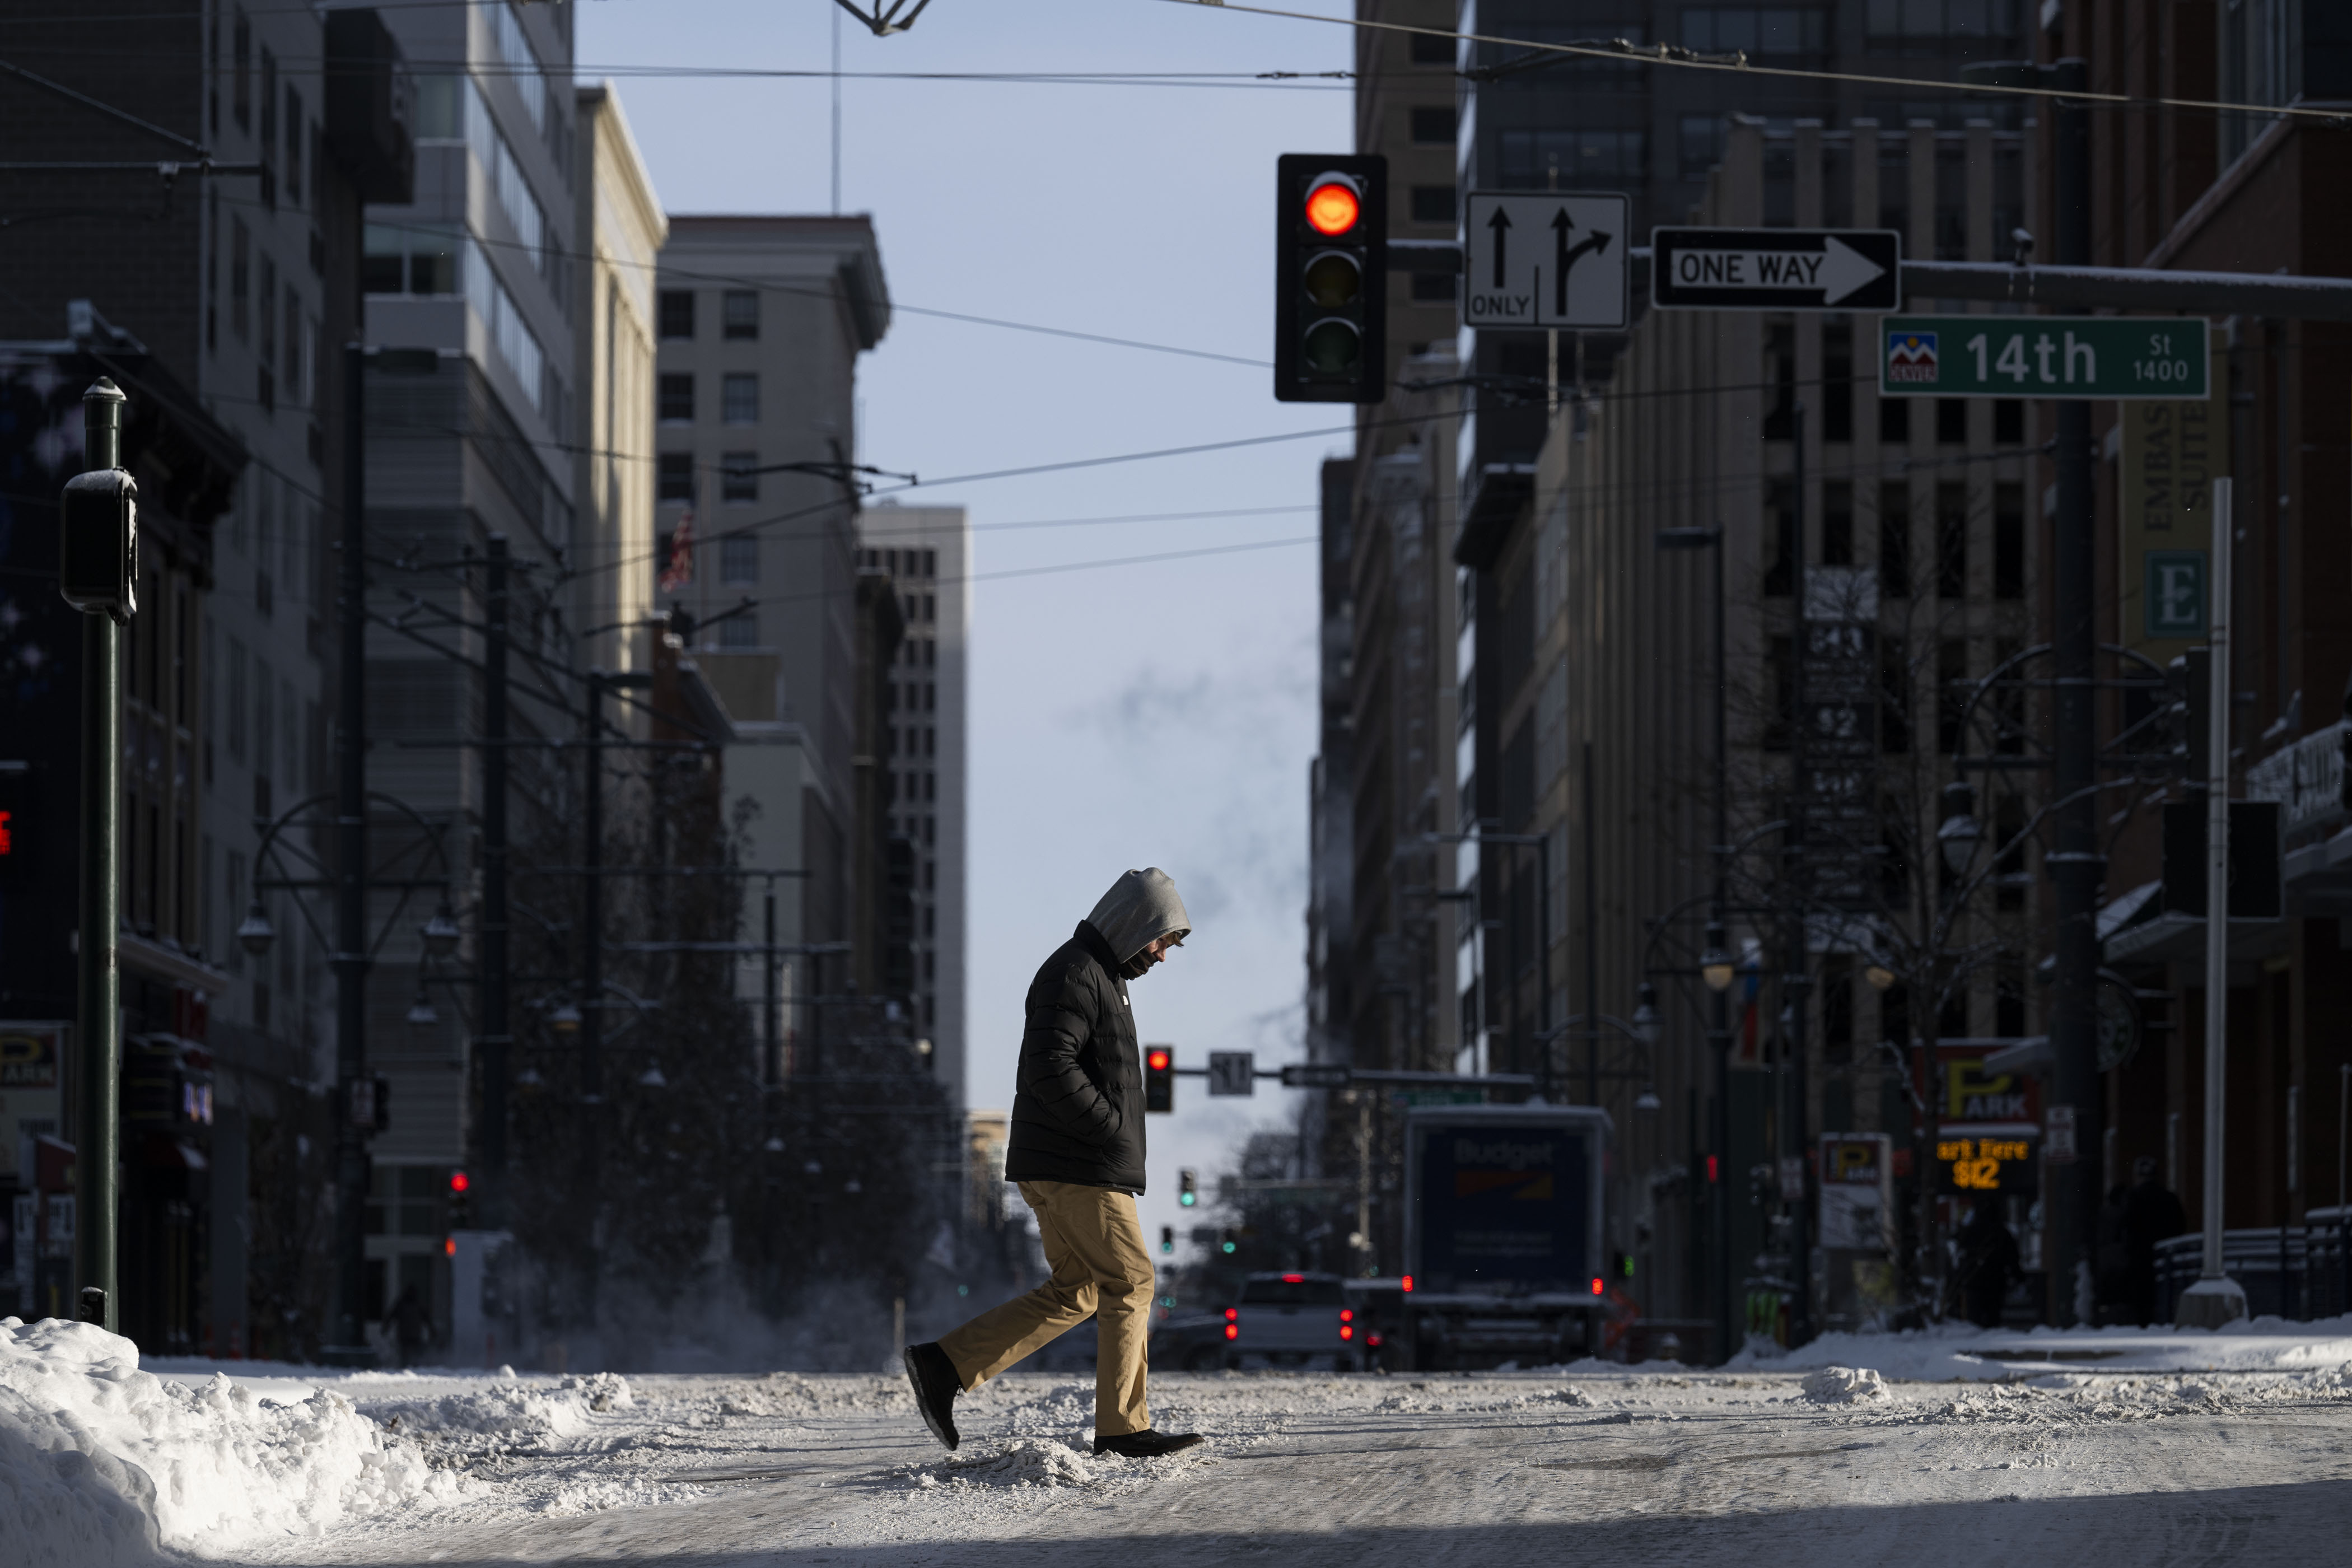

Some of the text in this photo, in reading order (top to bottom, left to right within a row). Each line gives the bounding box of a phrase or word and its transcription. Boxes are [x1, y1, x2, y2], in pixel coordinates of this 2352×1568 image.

[1680, 253, 1823, 284] ONE WAY
[1472, 295, 1530, 316] ONLY
[1966, 330, 2097, 384] 14th
[2149, 334, 2172, 356] St
[2133, 359, 2189, 382] 1400
[2144, 400, 2173, 531] EMBAS
[2180, 400, 2209, 511] SUITE
[1453, 1137, 1555, 1172] Budget
[1935, 1138, 1975, 1160] ark
